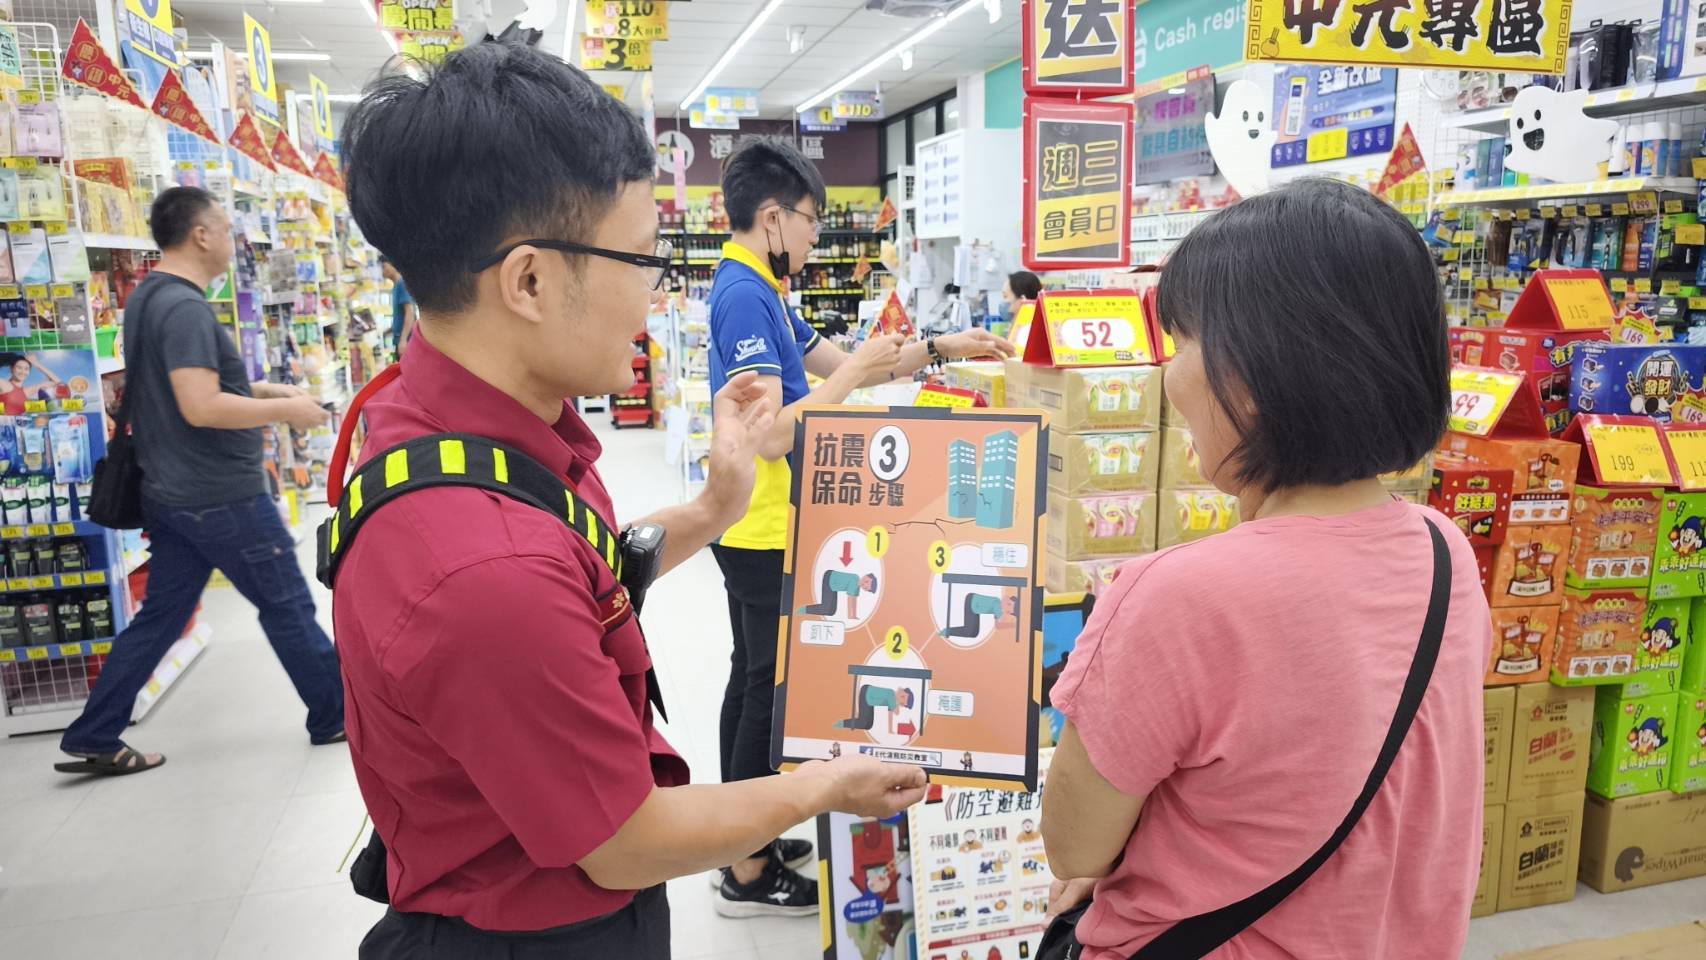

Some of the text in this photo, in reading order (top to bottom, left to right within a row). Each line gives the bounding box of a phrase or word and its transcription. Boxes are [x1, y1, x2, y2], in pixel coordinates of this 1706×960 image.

[1041, 0, 1121, 60] 送
[1154, 16, 1197, 52] Cash
[1042, 140, 1118, 192] 週三
[1043, 205, 1117, 241] 會員日
[1568, 305, 1589, 320] 115
[1082, 321, 1113, 348] 52
[815, 432, 865, 468] 抗震
[1611, 455, 1635, 472] 199
[1690, 461, 1706, 477] 11
[812, 470, 905, 507] 保命 步驟
[935, 546, 946, 568] 3
[892, 632, 903, 654] 2
